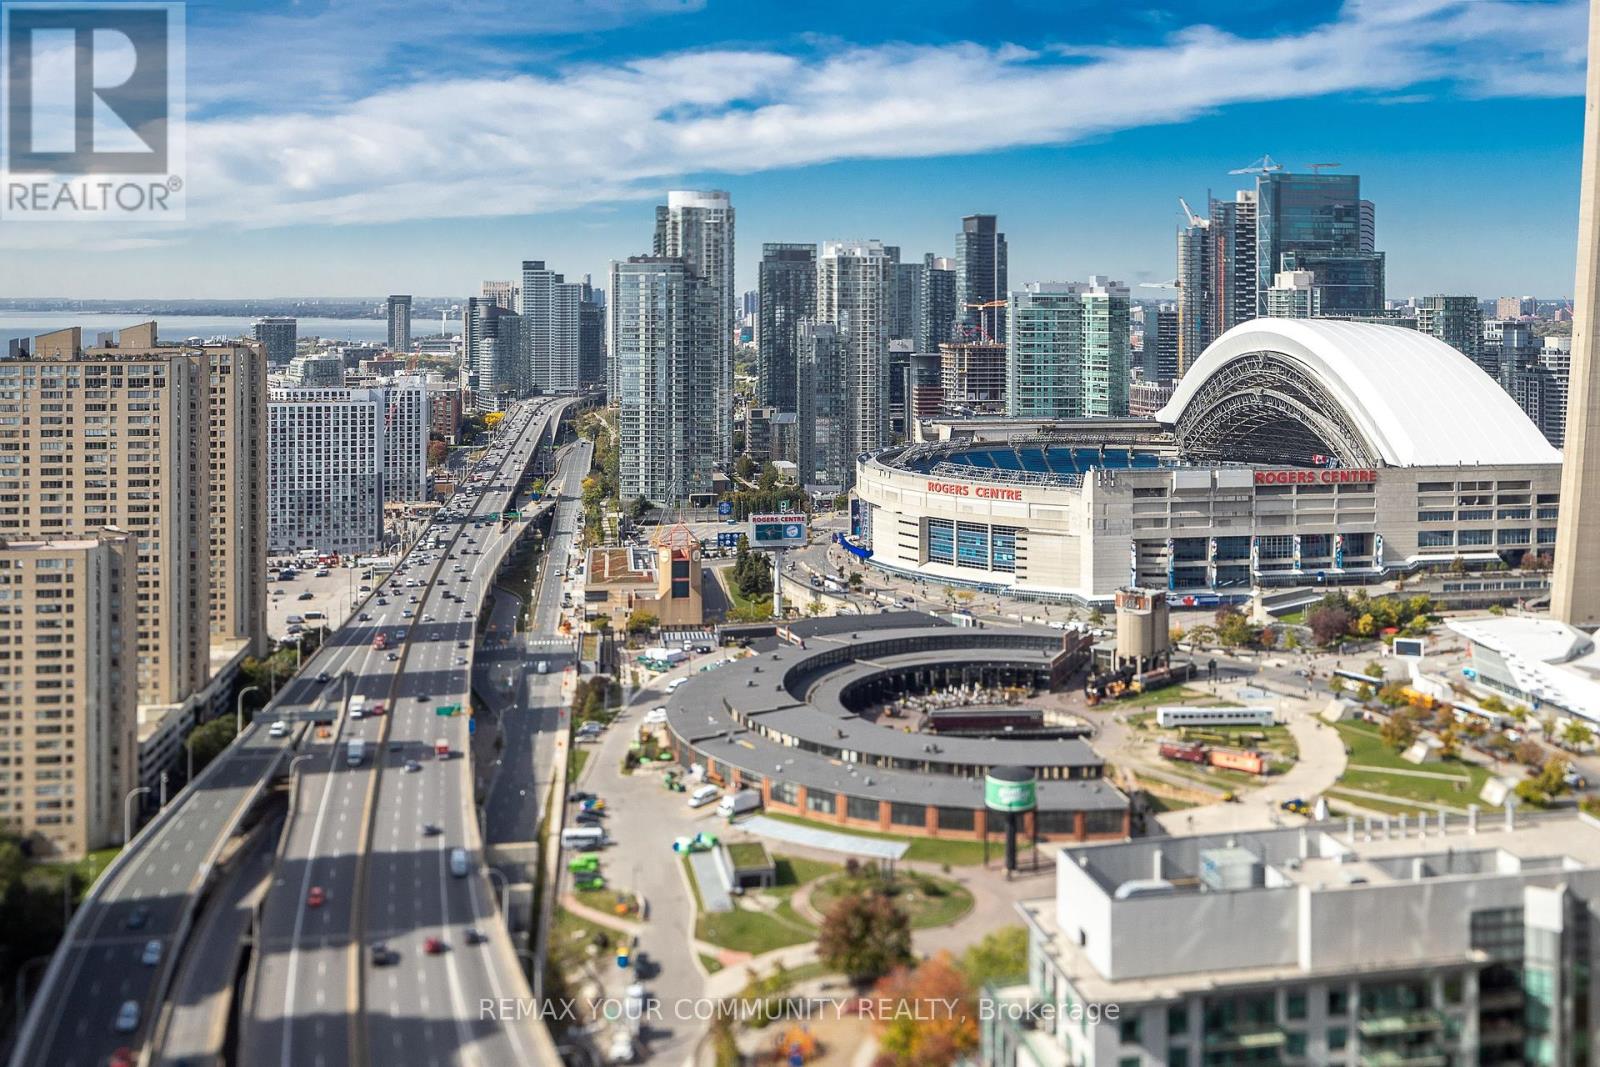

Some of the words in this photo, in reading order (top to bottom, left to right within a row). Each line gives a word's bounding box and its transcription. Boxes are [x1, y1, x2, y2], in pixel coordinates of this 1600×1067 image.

[1254, 470, 1316, 484] ROGERS
[1320, 470, 1377, 483] CENTRE
[927, 481, 969, 496] ROGERS
[975, 487, 1022, 501] CENTRE
